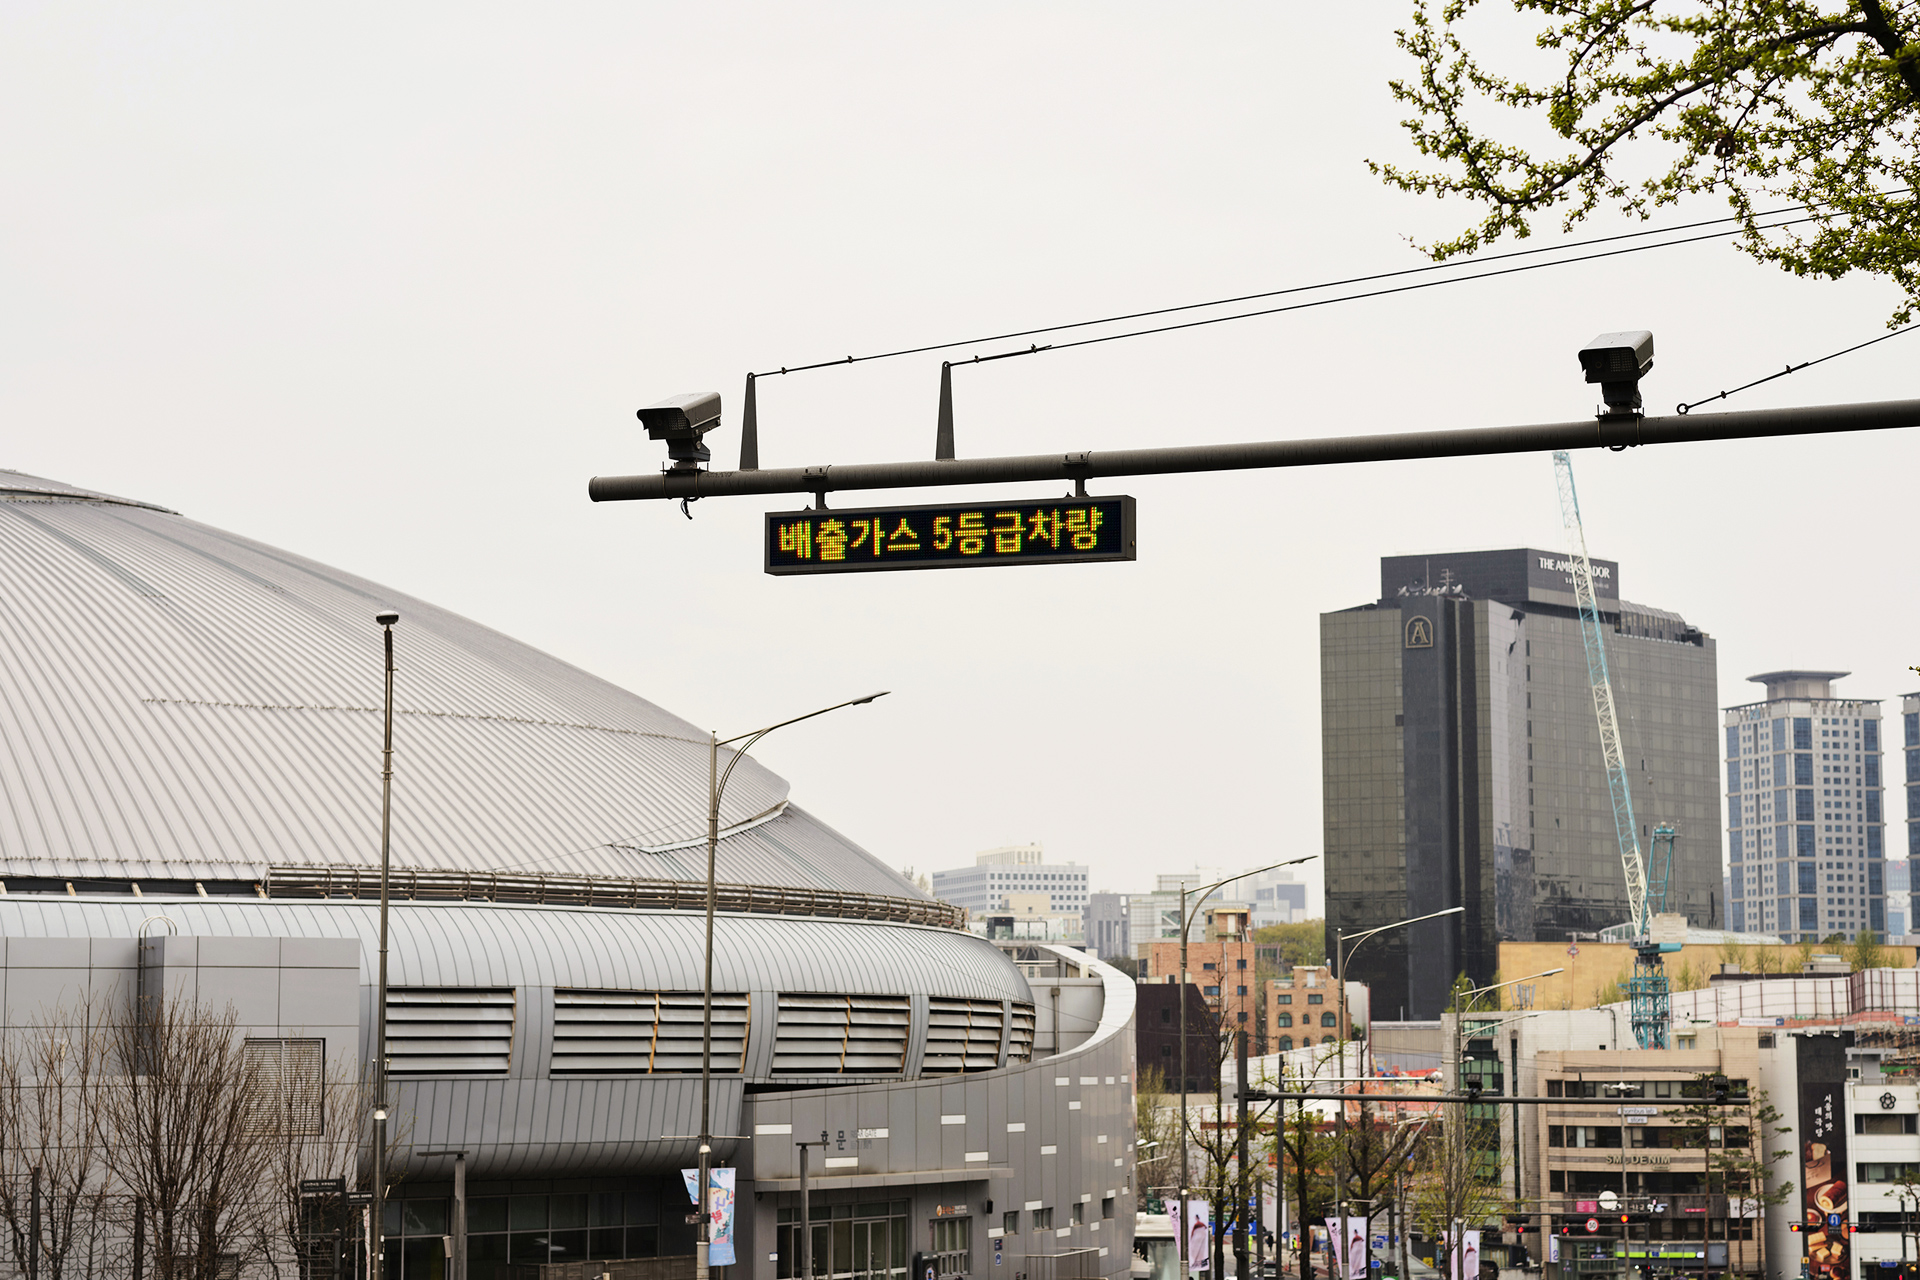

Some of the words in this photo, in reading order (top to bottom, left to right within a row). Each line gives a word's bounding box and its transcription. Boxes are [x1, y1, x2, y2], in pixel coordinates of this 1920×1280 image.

[778, 517, 921, 561] 배출가스
[932, 506, 1104, 554] 5등급차량
[1539, 557, 1555, 571] THE
[1824, 1093, 1833, 1120] 서울의
[1814, 1106, 1824, 1137] 태극당
[1631, 1154, 1671, 1165] DENIM
[1588, 1221, 1597, 1229] 50
